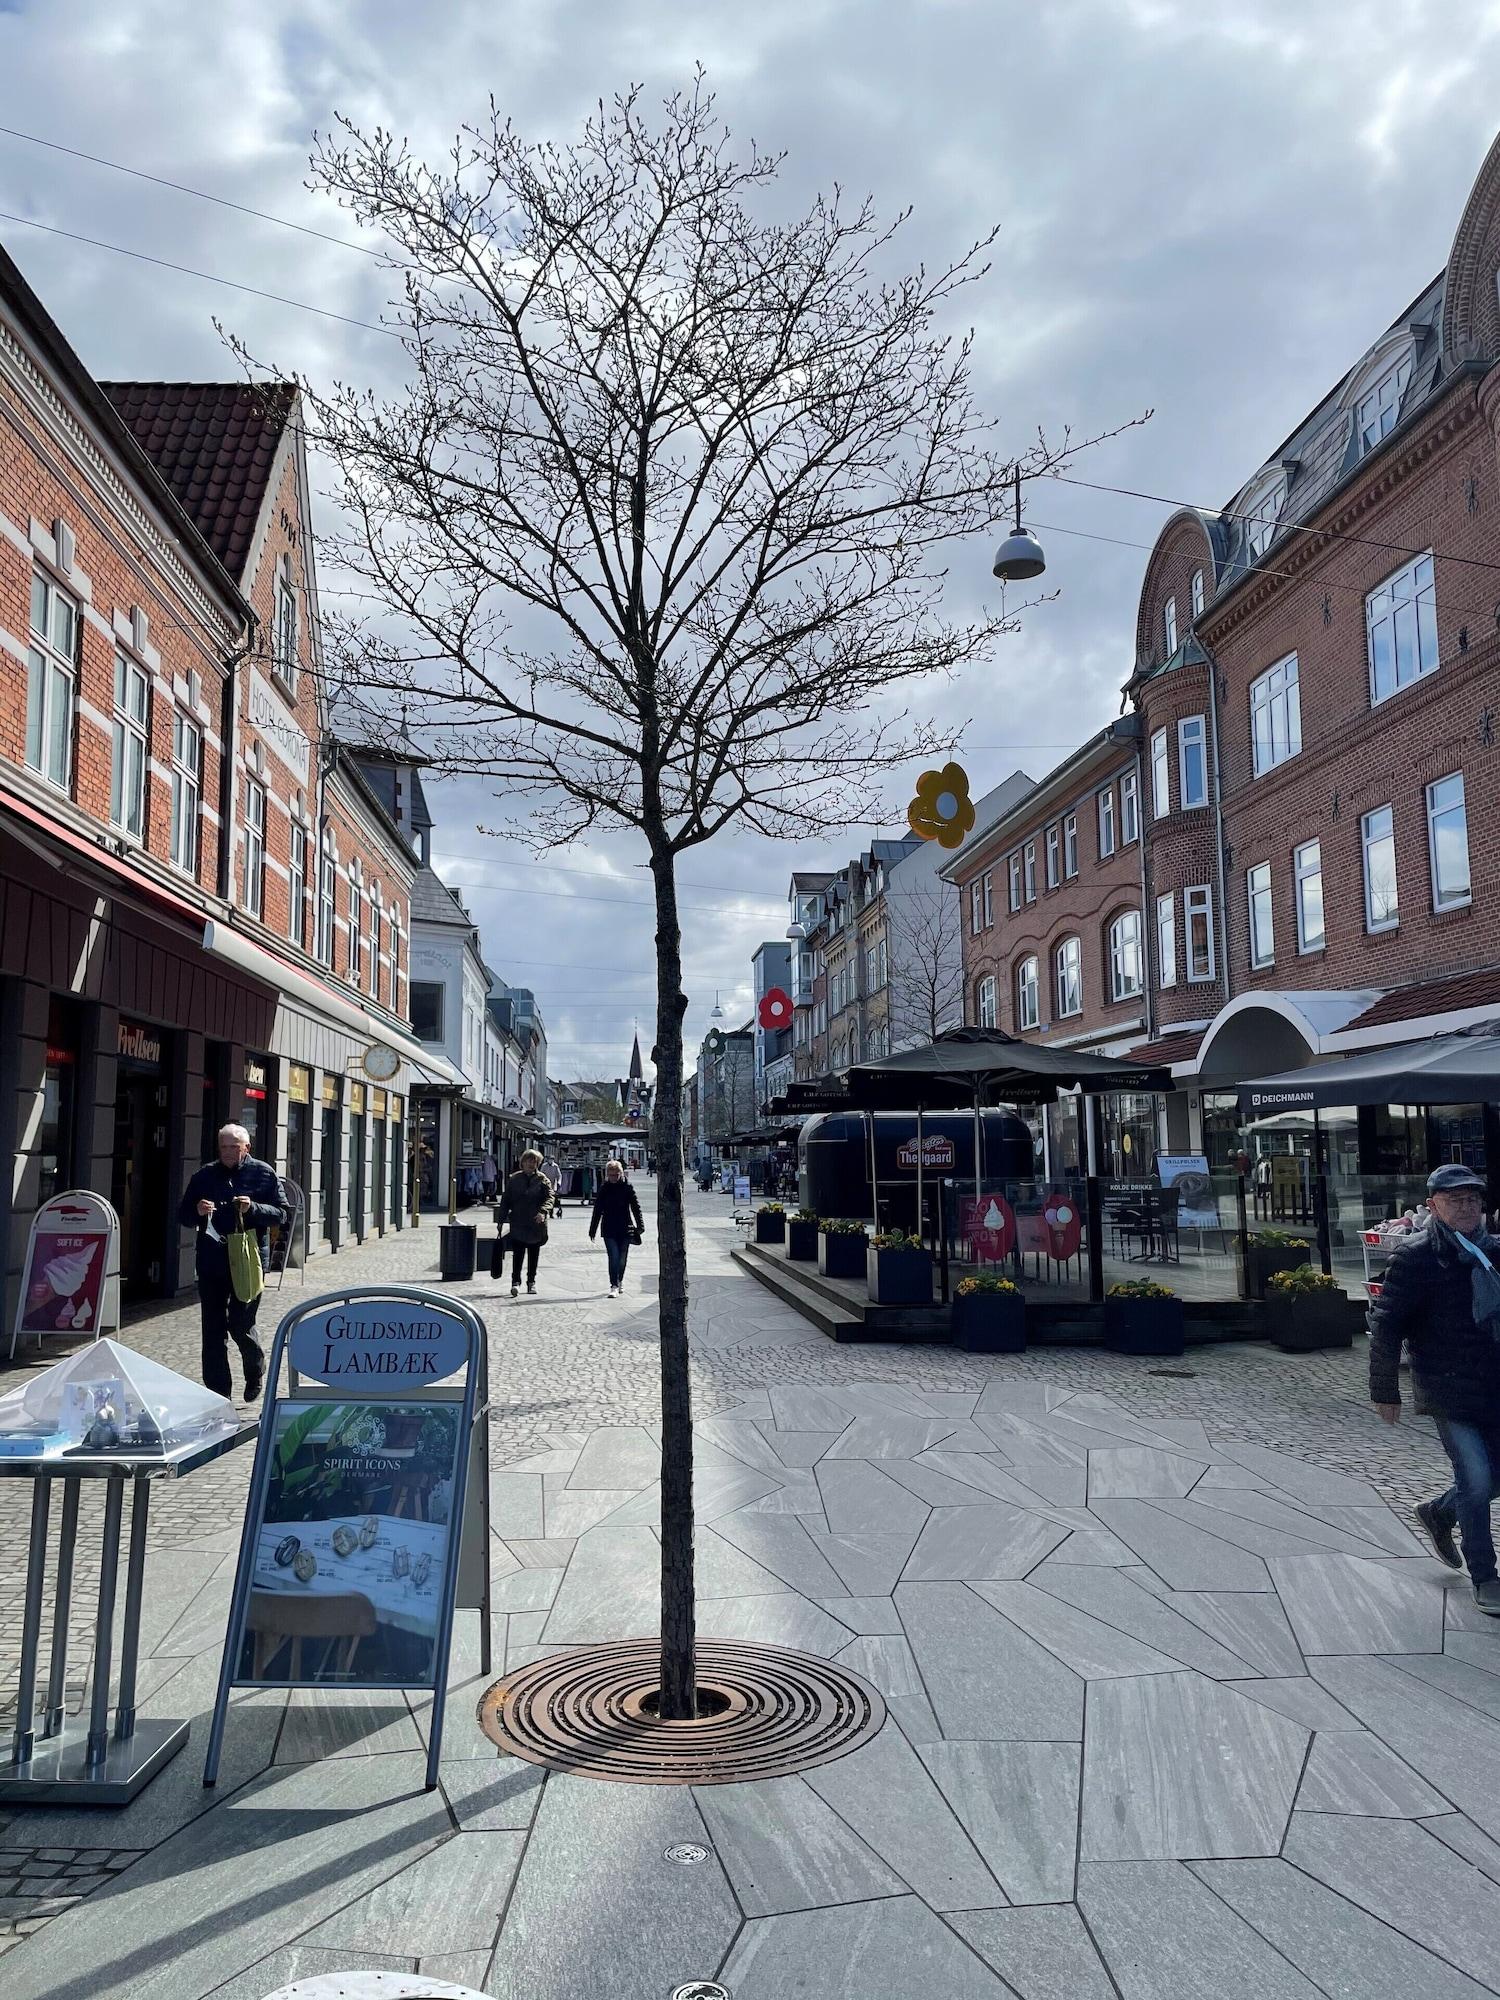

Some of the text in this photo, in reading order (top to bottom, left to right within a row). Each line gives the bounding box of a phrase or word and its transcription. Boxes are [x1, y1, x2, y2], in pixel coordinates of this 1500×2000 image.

[252, 682, 277, 736] HOTEL
[117, 1023, 160, 1062] Frellsen
[1262, 1092, 1314, 1104] DEICHMANN
[56, 1238, 83, 1247] SOFT ICE
[325, 1314, 442, 1341] GULDSMED
[320, 1344, 439, 1375] LAMBÆK
[323, 1458, 401, 1473] SPIRIT ICONS
